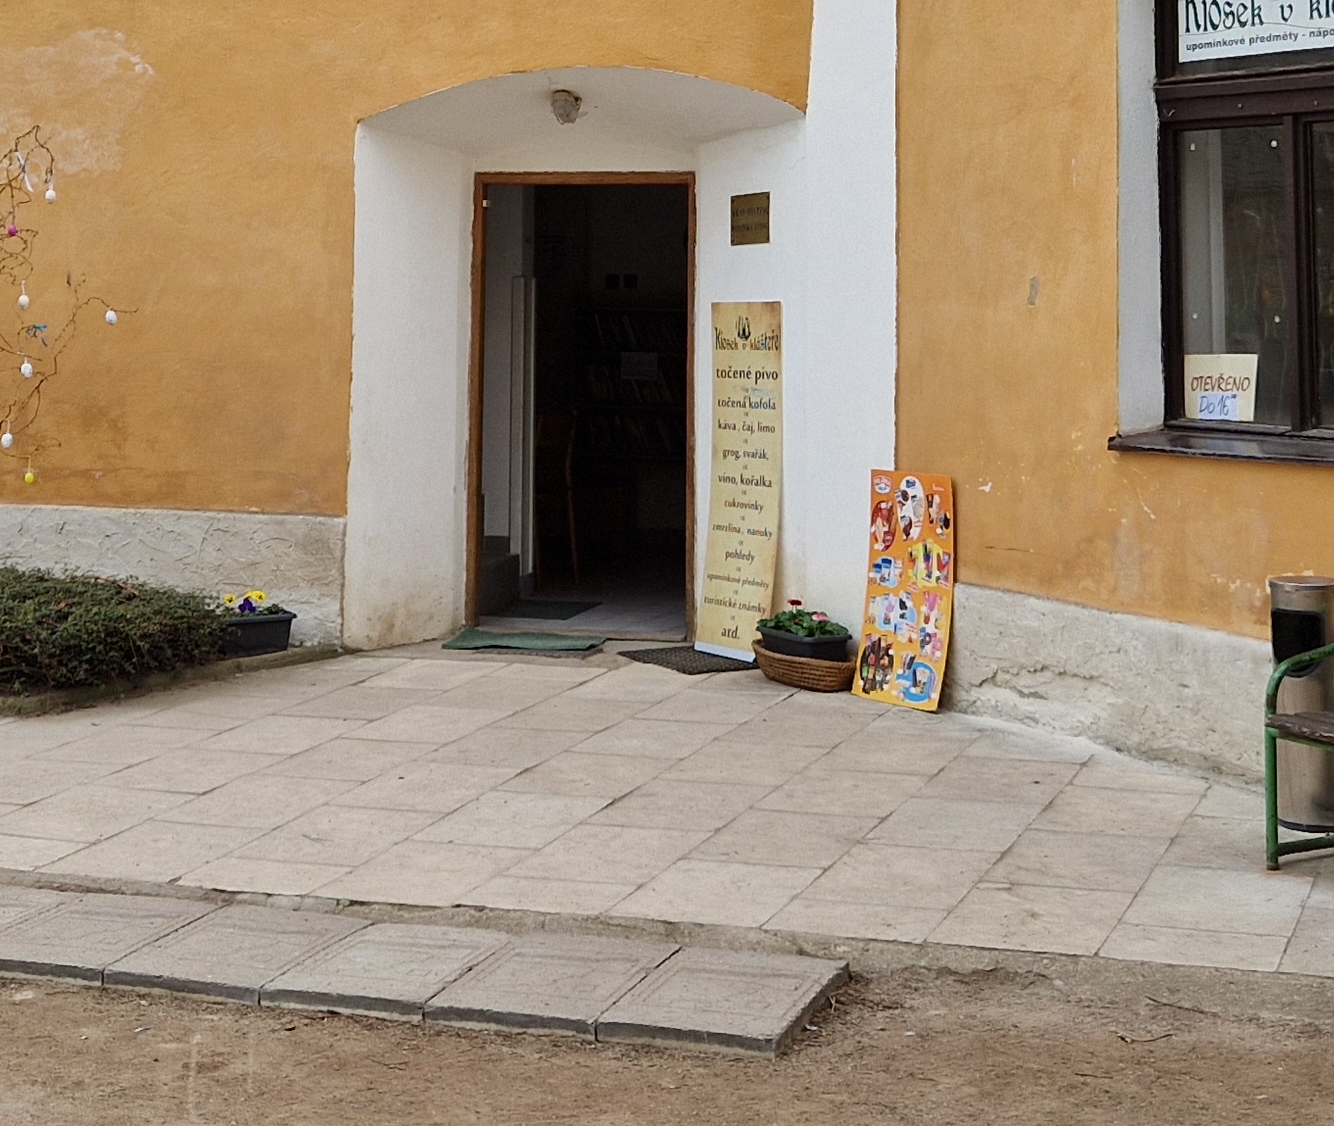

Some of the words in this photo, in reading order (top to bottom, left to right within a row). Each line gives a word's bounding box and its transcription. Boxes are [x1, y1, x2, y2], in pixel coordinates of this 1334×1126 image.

[1279, 3, 1294, 23] v
[1248, 31, 1299, 47] předměty
[716, 365, 752, 380] točené
[754, 366, 779, 385] pivo
[1190, 373, 1251, 392] OTEVŘENO
[717, 395, 747, 409] točená
[748, 396, 776, 410] kofola
[1198, 395, 1216, 414] Do
[757, 421, 776, 433] limo
[740, 473, 773, 488] kořalka
[724, 497, 764, 514] cukrovinky
[724, 548, 755, 565] pohledy
